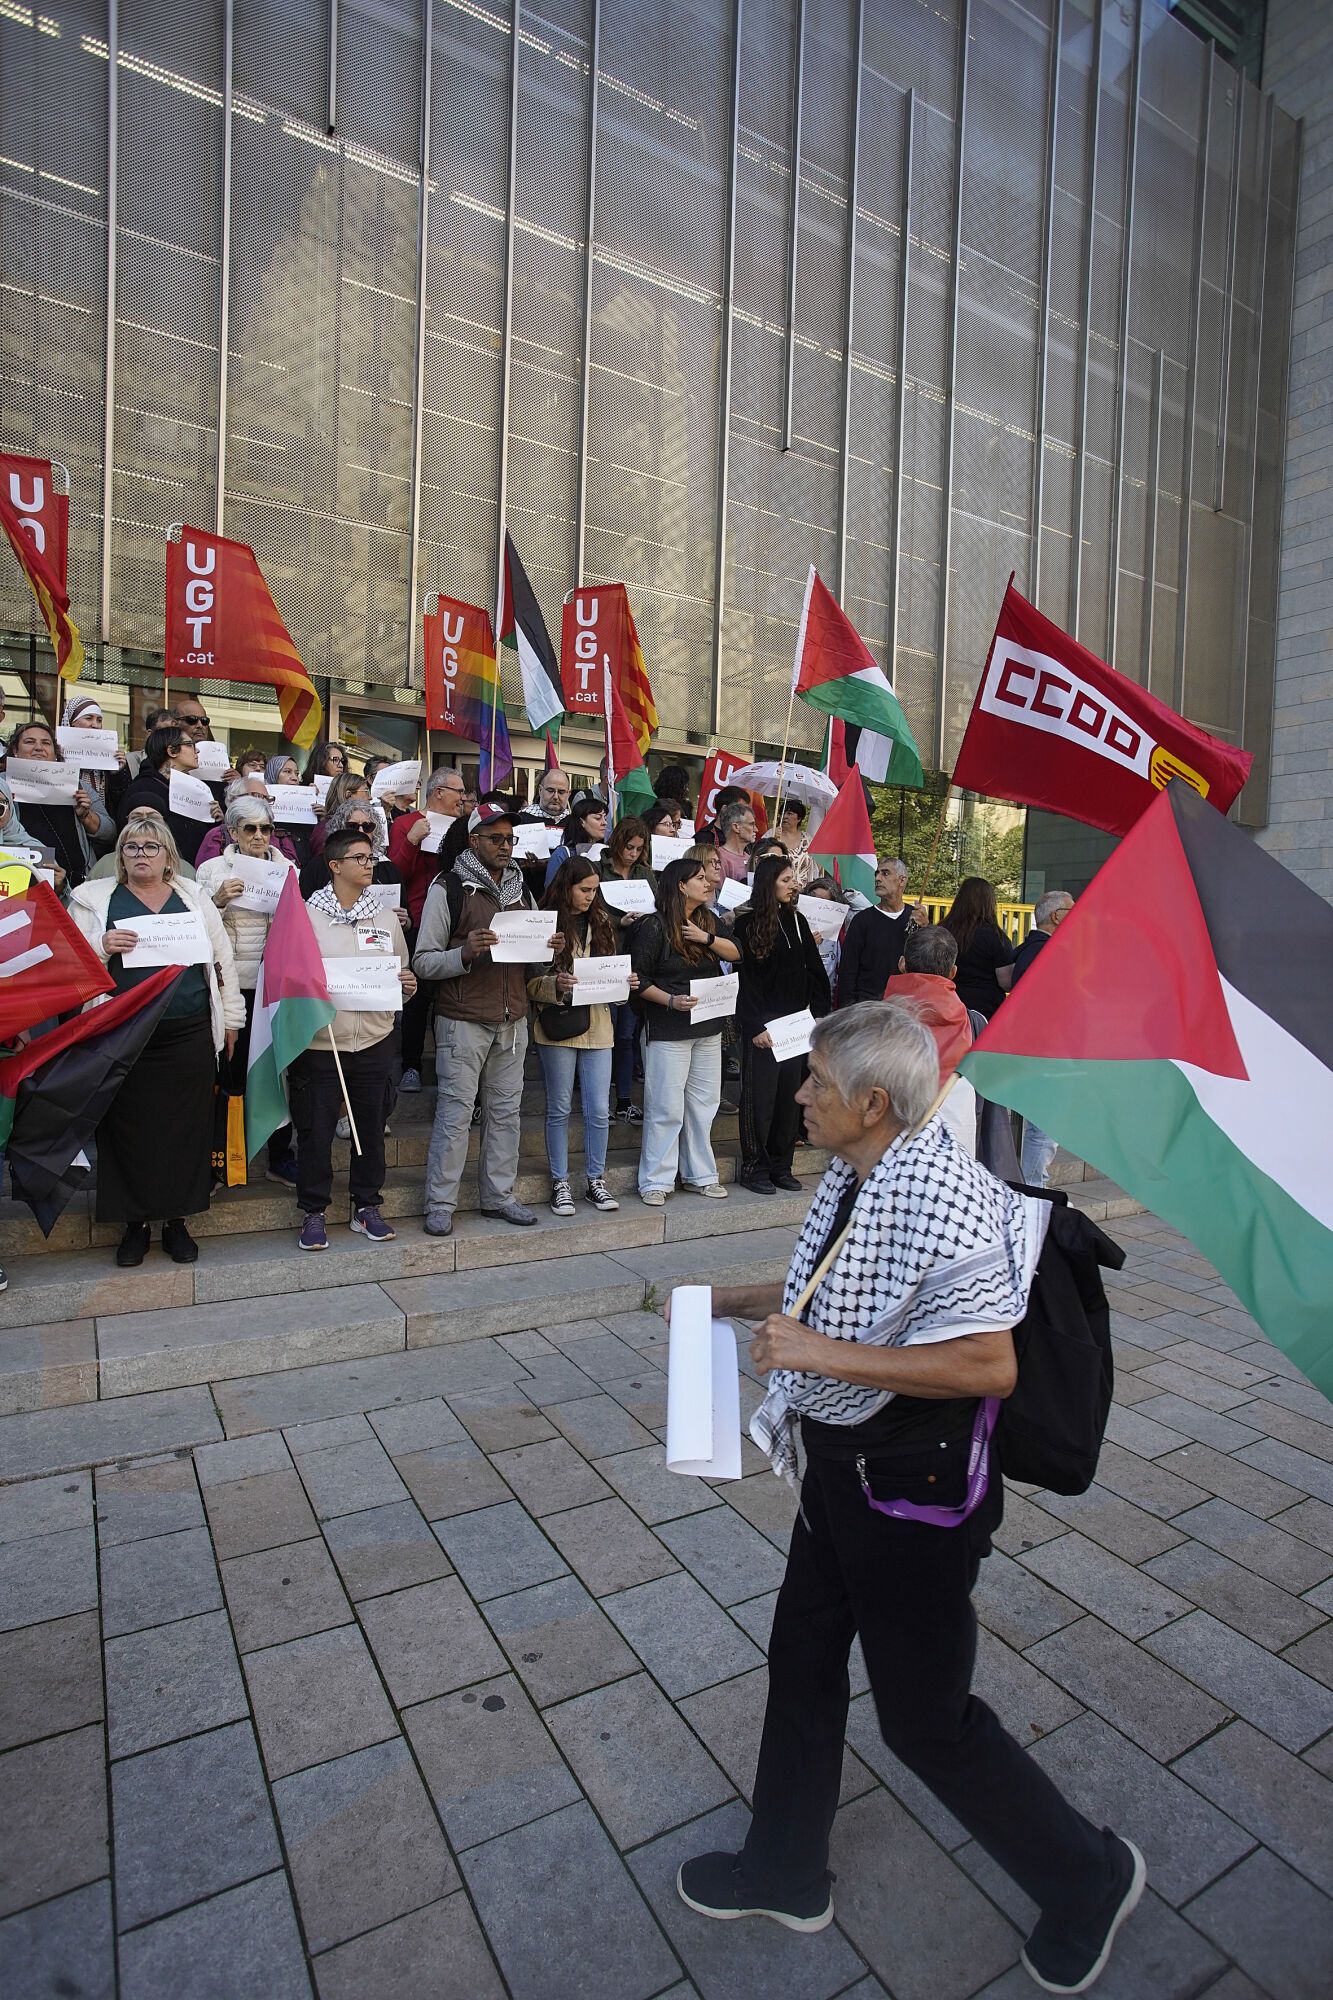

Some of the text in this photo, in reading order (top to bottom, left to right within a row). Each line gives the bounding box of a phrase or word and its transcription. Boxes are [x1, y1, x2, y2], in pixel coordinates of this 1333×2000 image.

[185, 543, 215, 648] UGT
[180, 651, 214, 665] .cat
[442, 612, 464, 708] UGT
[575, 599, 598, 689] UGT
[570, 691, 597, 702] .cat
[995, 658, 1141, 760] CCOO
[153, 934, 176, 942] Sheikh
